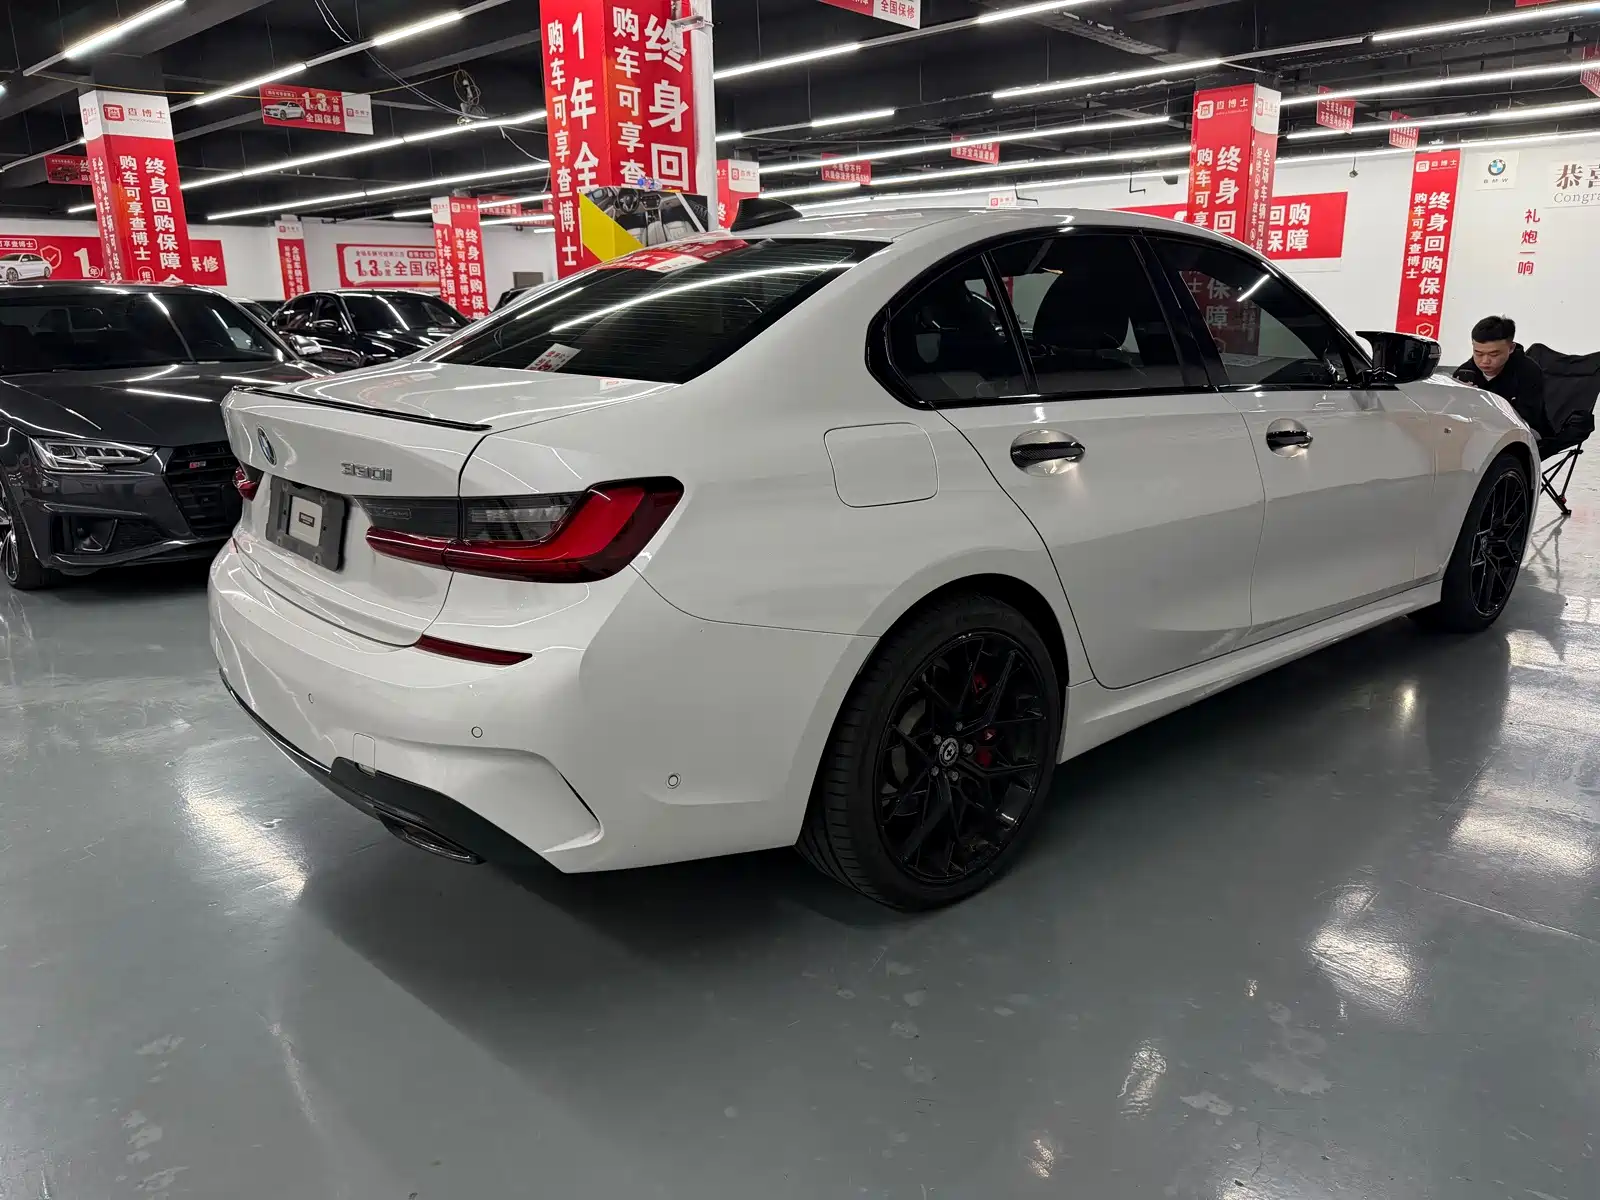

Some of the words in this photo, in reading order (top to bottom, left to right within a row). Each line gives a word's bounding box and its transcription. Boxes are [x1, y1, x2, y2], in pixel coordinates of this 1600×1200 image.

[880, 0, 915, 19] 全国保修
[306, 113, 341, 126] 全国保修
[1216, 97, 1249, 110] 查博士
[547, 20, 578, 266] 购车可享查博士
[119, 155, 151, 261] 购车可享查博士
[1192, 147, 1214, 227] 购车可享
[1214, 145, 1241, 235] 终身回
[1269, 203, 1311, 226] 回购
[0, 240, 34, 248] 享查博士
[455, 228, 470, 306] 购车可享查博士
[1406, 193, 1427, 279] 购车可享查博士
[1416, 191, 1450, 316] 终身回购保障
[1518, 208, 1541, 276] 礼炮一响
[341, 461, 393, 483] 330i
